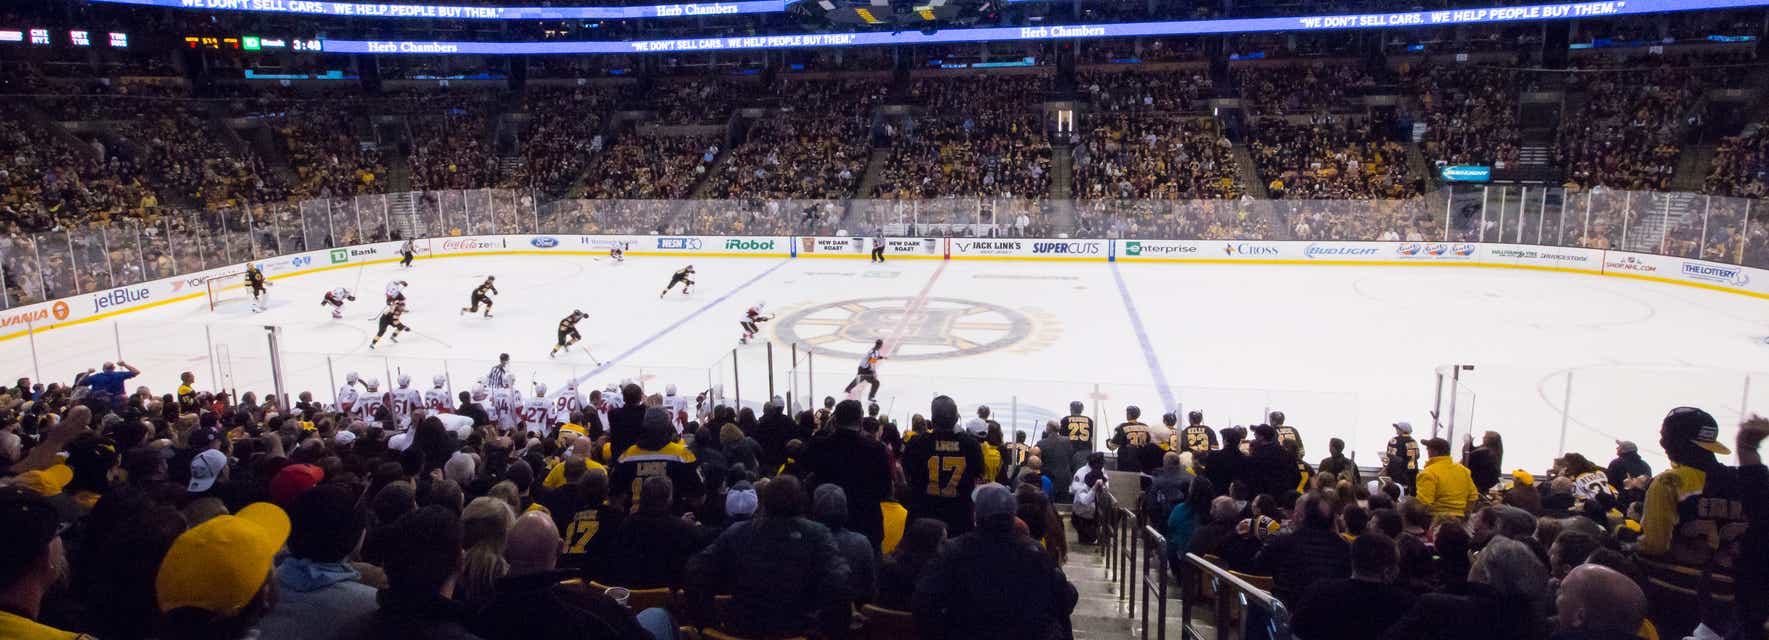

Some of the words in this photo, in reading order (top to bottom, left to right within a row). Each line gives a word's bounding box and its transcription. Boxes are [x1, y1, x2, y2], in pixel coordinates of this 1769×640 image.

[210, 0, 250, 9] DON'T
[254, 0, 287, 11] SELL
[290, 1, 327, 13] CARS.
[334, 4, 352, 14] WE
[356, 4, 387, 15] HELP
[390, 5, 436, 16] PEOPLE
[438, 7, 462, 17] BUY
[464, 8, 504, 18] THEM."
[656, 4, 682, 16] Herb
[685, 3, 738, 15] Chambers
[1324, 16, 1357, 27] DON'T
[1360, 15, 1386, 26] SELL
[1390, 14, 1424, 25] CARS.
[1431, 11, 1450, 22] WE
[1453, 11, 1487, 22] HELP
[1489, 7, 1541, 20] PEOPLE
[1542, 5, 1570, 17] BUY
[1574, 1, 1626, 15] THEM."
[1020, 27, 1047, 38] Herb
[1050, 25, 1105, 37] Chambers
[368, 42, 397, 52] Herb
[400, 42, 458, 52] Chambers
[650, 40, 675, 50] DON'T
[677, 40, 697, 49] SELL
[699, 39, 724, 49] CARS.
[727, 38, 742, 48] WE
[743, 37, 766, 47] HELP
[768, 36, 801, 46] PEOPLE
[803, 35, 822, 45] BUY
[823, 34, 856, 44] THEM."
[351, 247, 377, 257] Bank
[725, 239, 775, 250] iRobot
[995, 242, 1021, 250] LINK'S
[1032, 242, 1100, 254] SUPERCUTS
[1685, 264, 1700, 273] THE
[1700, 266, 1737, 278] LOTTERY
[93, 285, 150, 312] jetBlue
[0, 308, 48, 327] VANIA
[557, 396, 577, 412] 90
[527, 407, 548, 423] 27
[1068, 423, 1090, 442] 25
[927, 456, 967, 497] 17
[562, 520, 600, 554] 17
